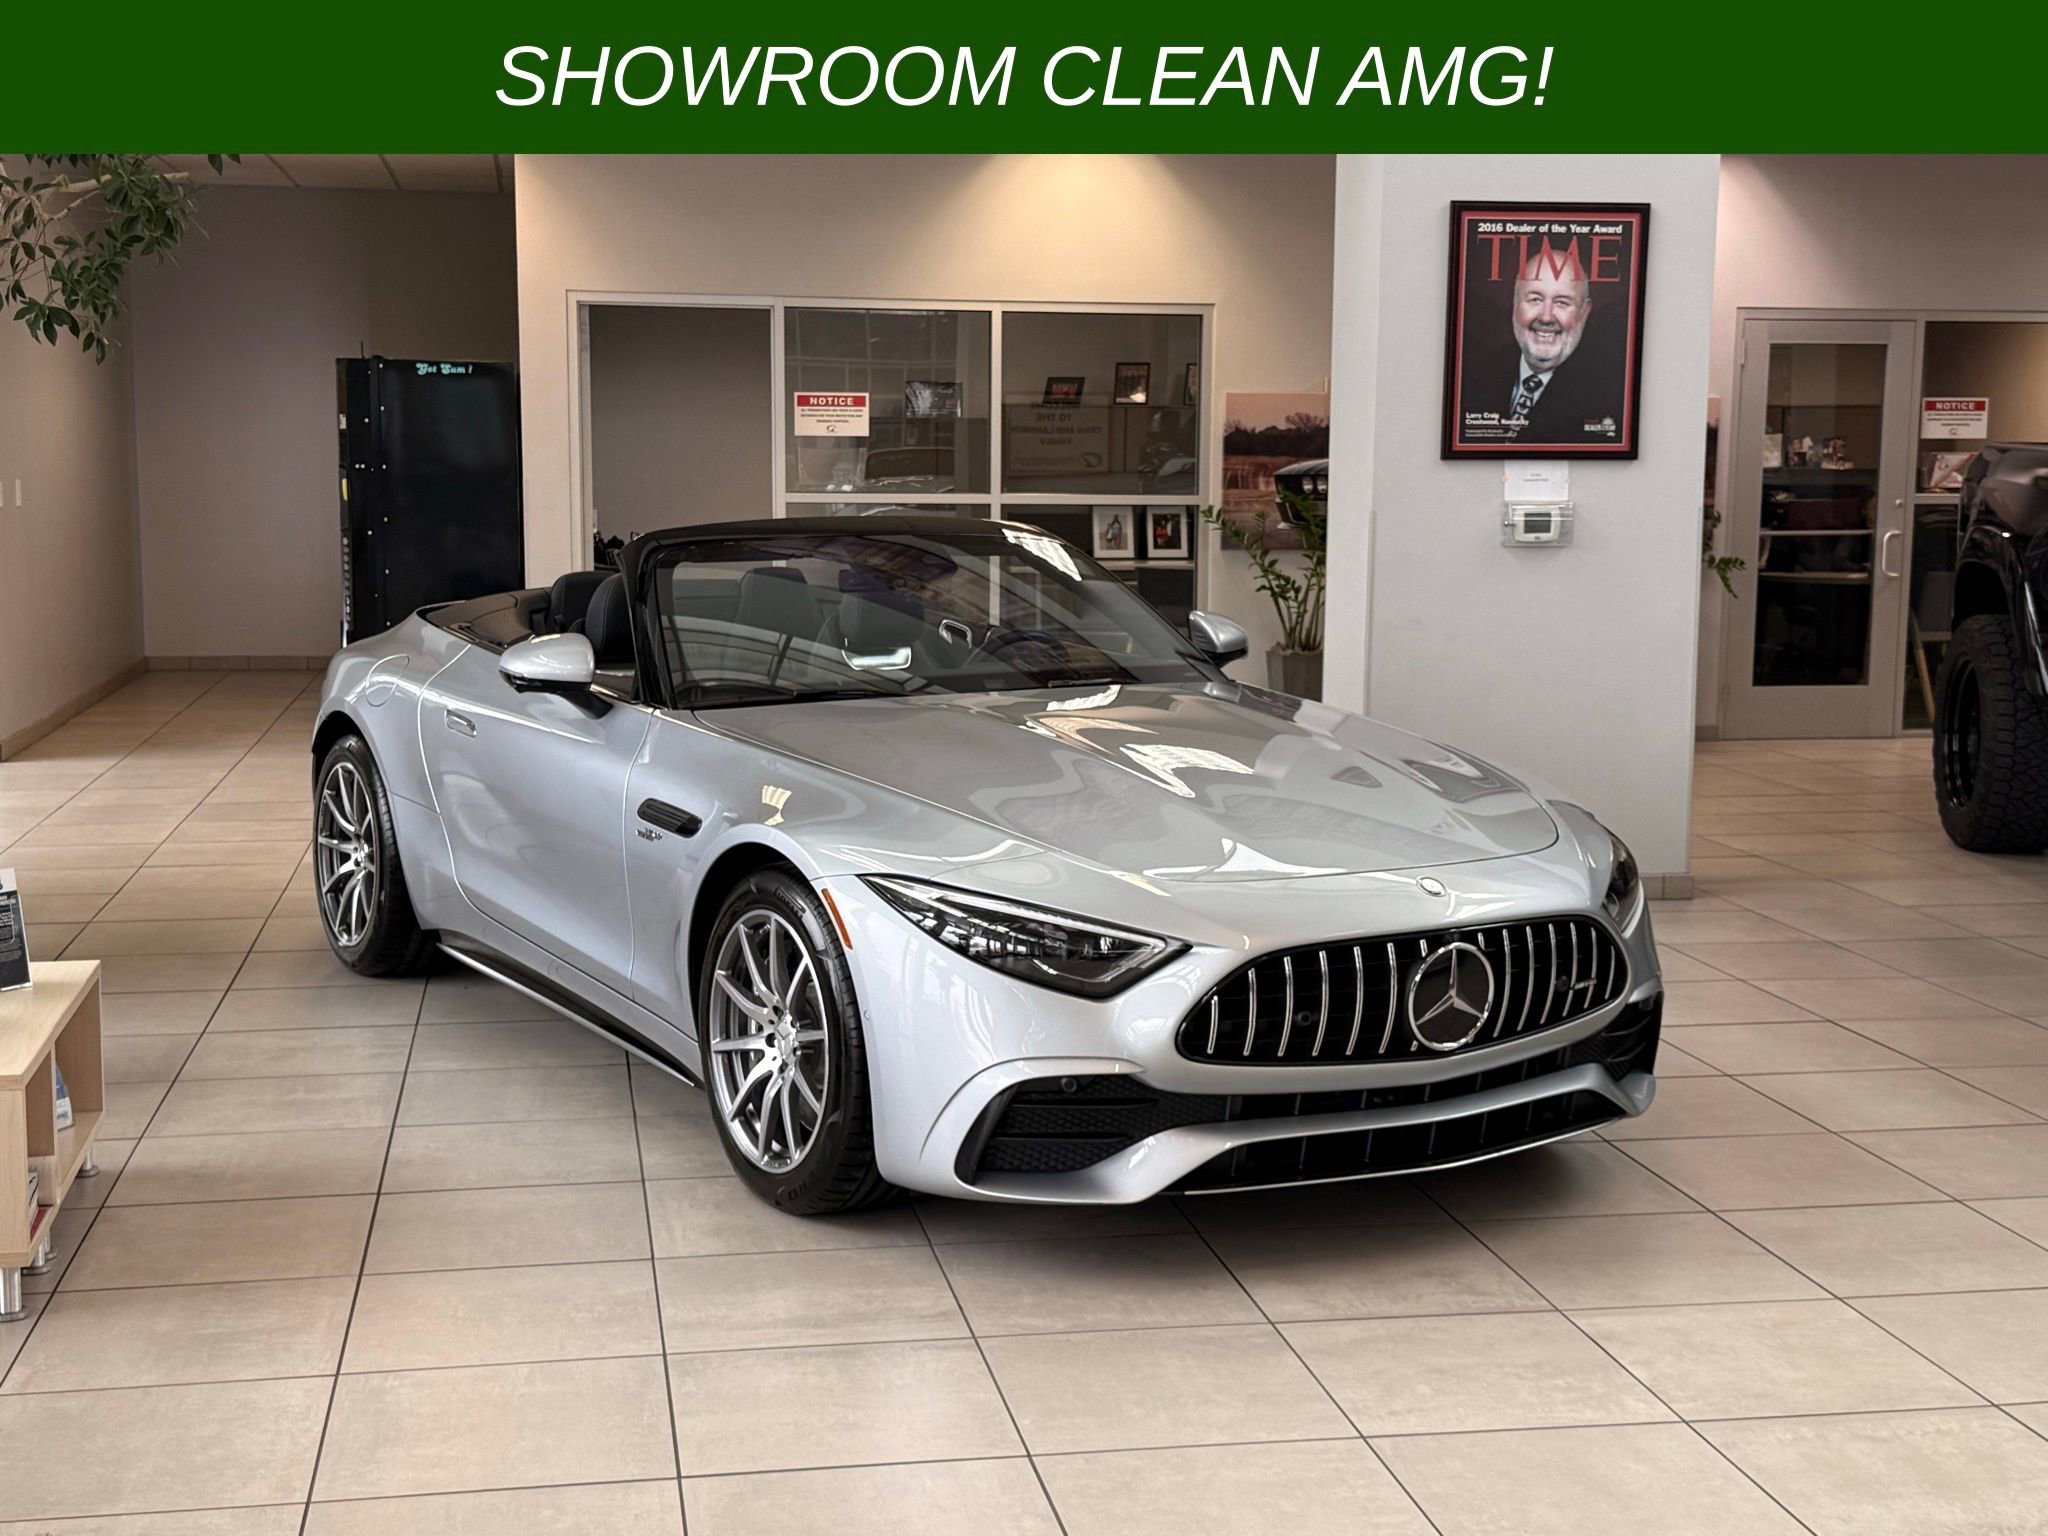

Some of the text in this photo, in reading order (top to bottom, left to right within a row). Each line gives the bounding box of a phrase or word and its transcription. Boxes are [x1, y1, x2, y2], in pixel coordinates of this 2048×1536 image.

[1477, 222, 1623, 234] 2016 Dealer of the Year Award
[1476, 234, 1622, 282] TIME
[809, 397, 854, 406] NOTICE
[1935, 402, 1976, 410] NOTICE
